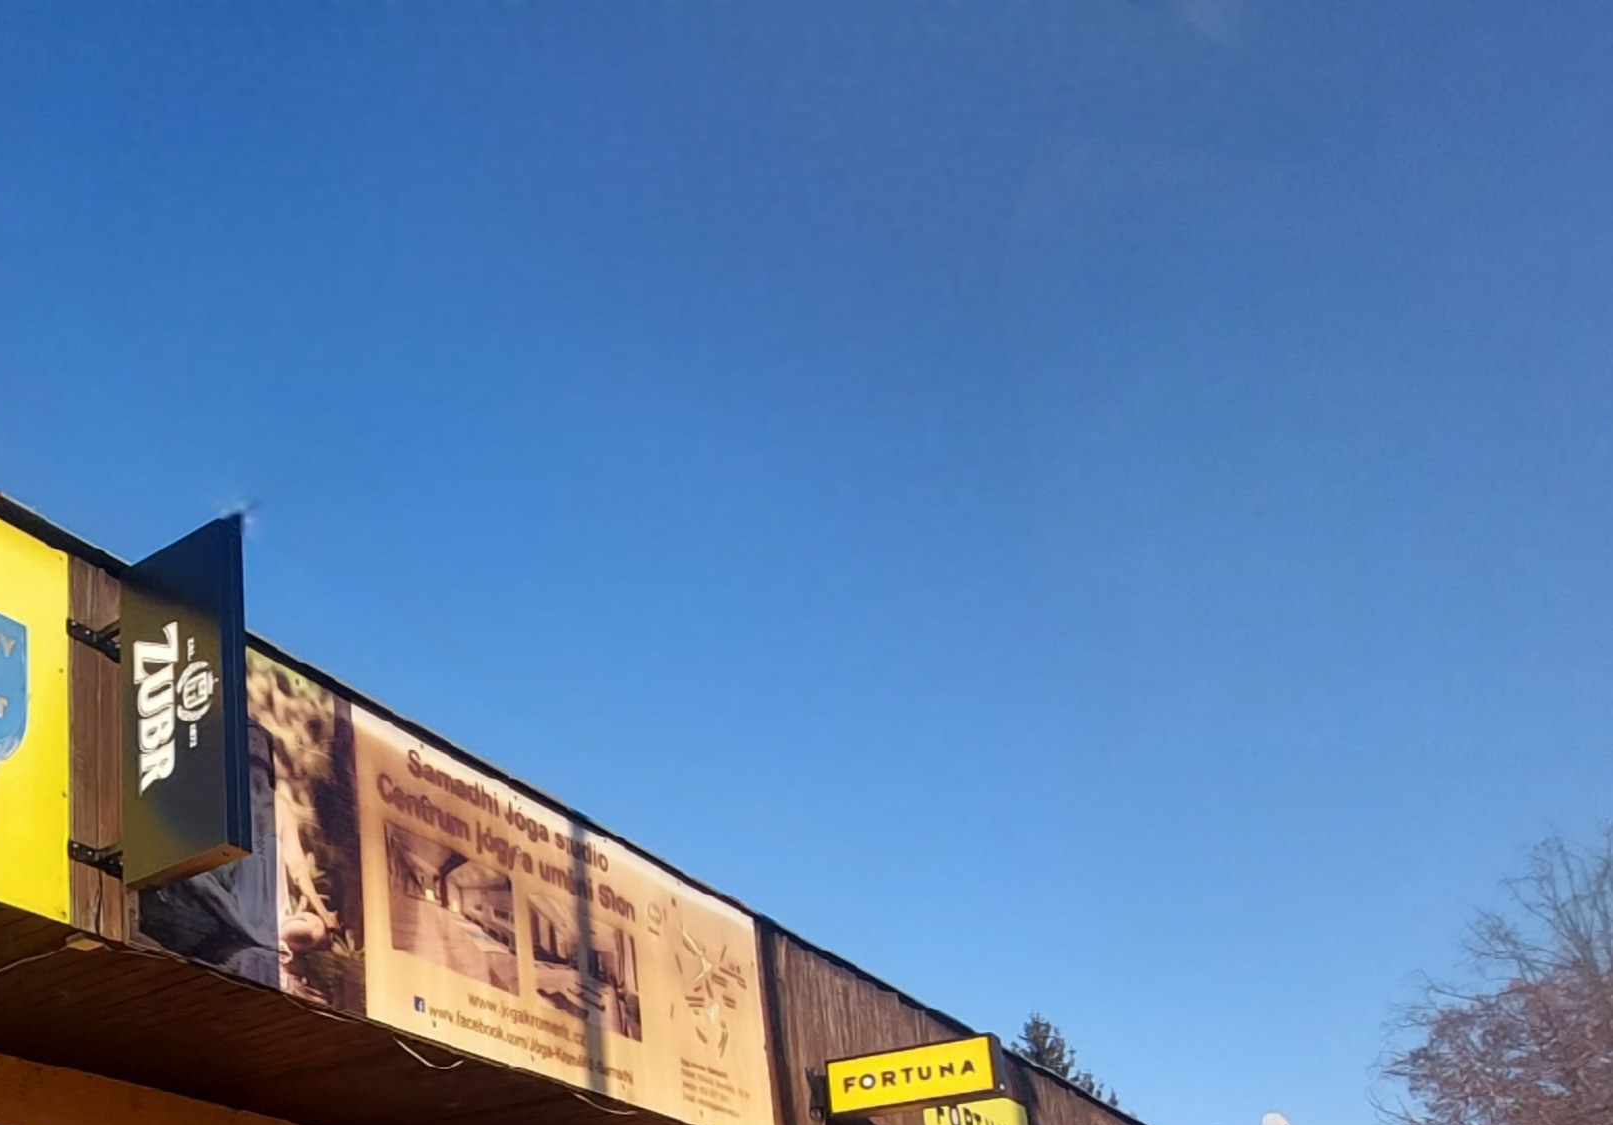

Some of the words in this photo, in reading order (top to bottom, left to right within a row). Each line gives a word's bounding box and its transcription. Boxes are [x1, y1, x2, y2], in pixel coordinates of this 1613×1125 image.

[133, 621, 179, 797] ZUBR
[376, 772, 470, 842] Centrum
[843, 1060, 976, 1093] FORTUNA
